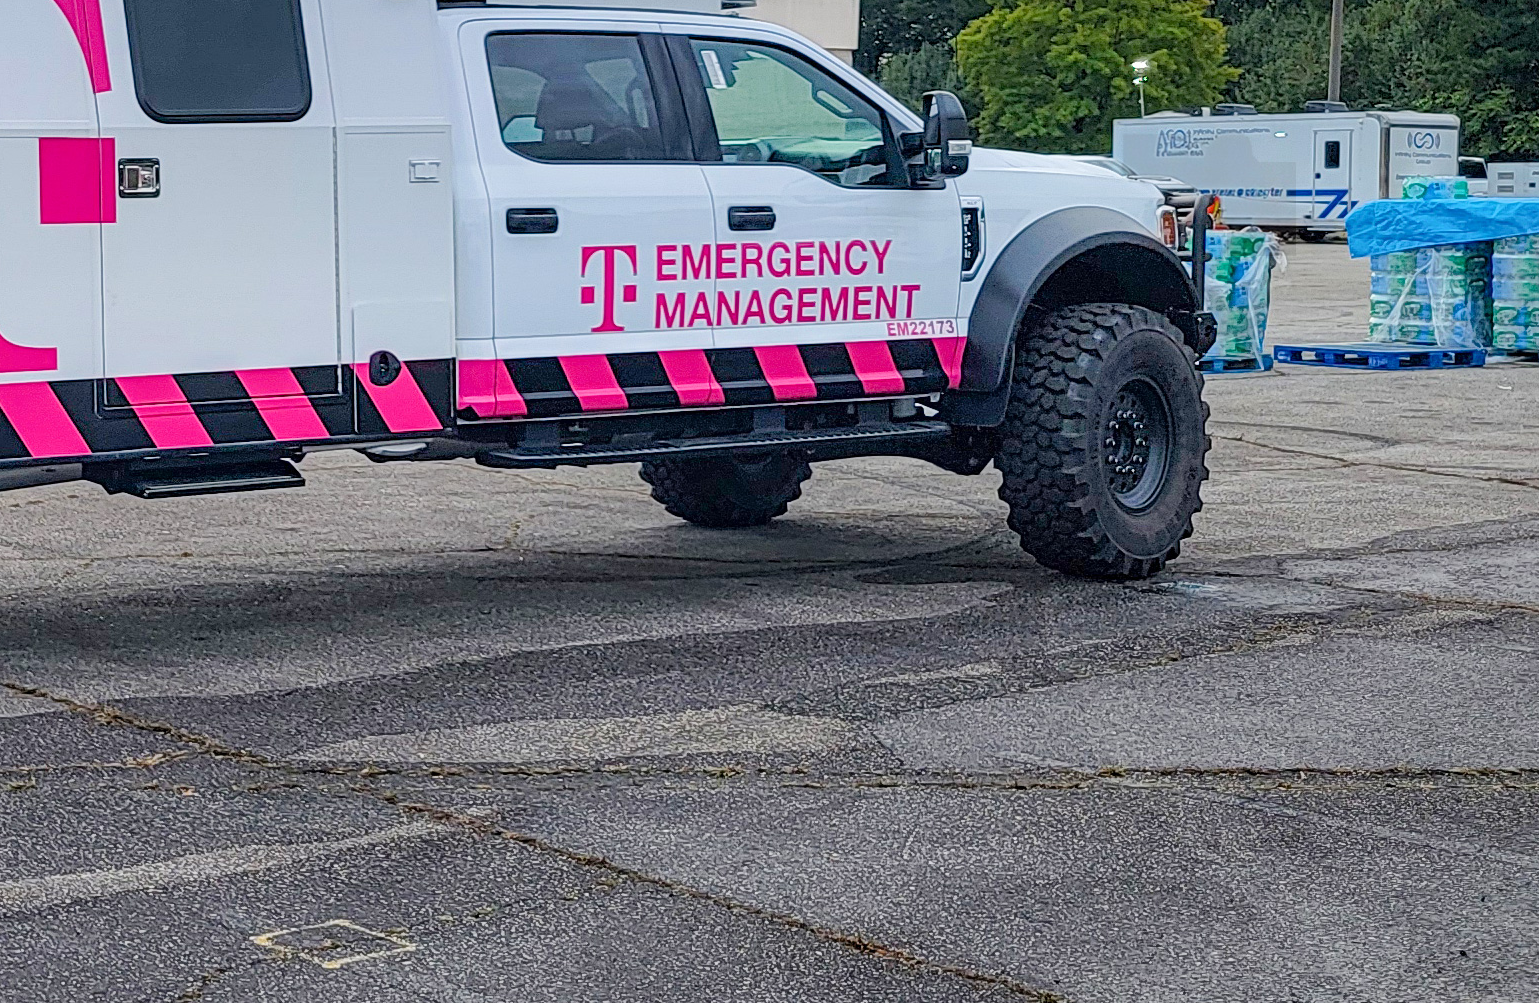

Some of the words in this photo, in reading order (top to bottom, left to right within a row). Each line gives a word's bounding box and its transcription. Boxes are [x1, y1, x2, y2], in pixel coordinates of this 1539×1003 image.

[655, 240, 893, 282] EMERGENCY
[580, 245, 638, 333] T
[654, 285, 921, 330] MANAGEMENT
[886, 319, 955, 337] EM22173
